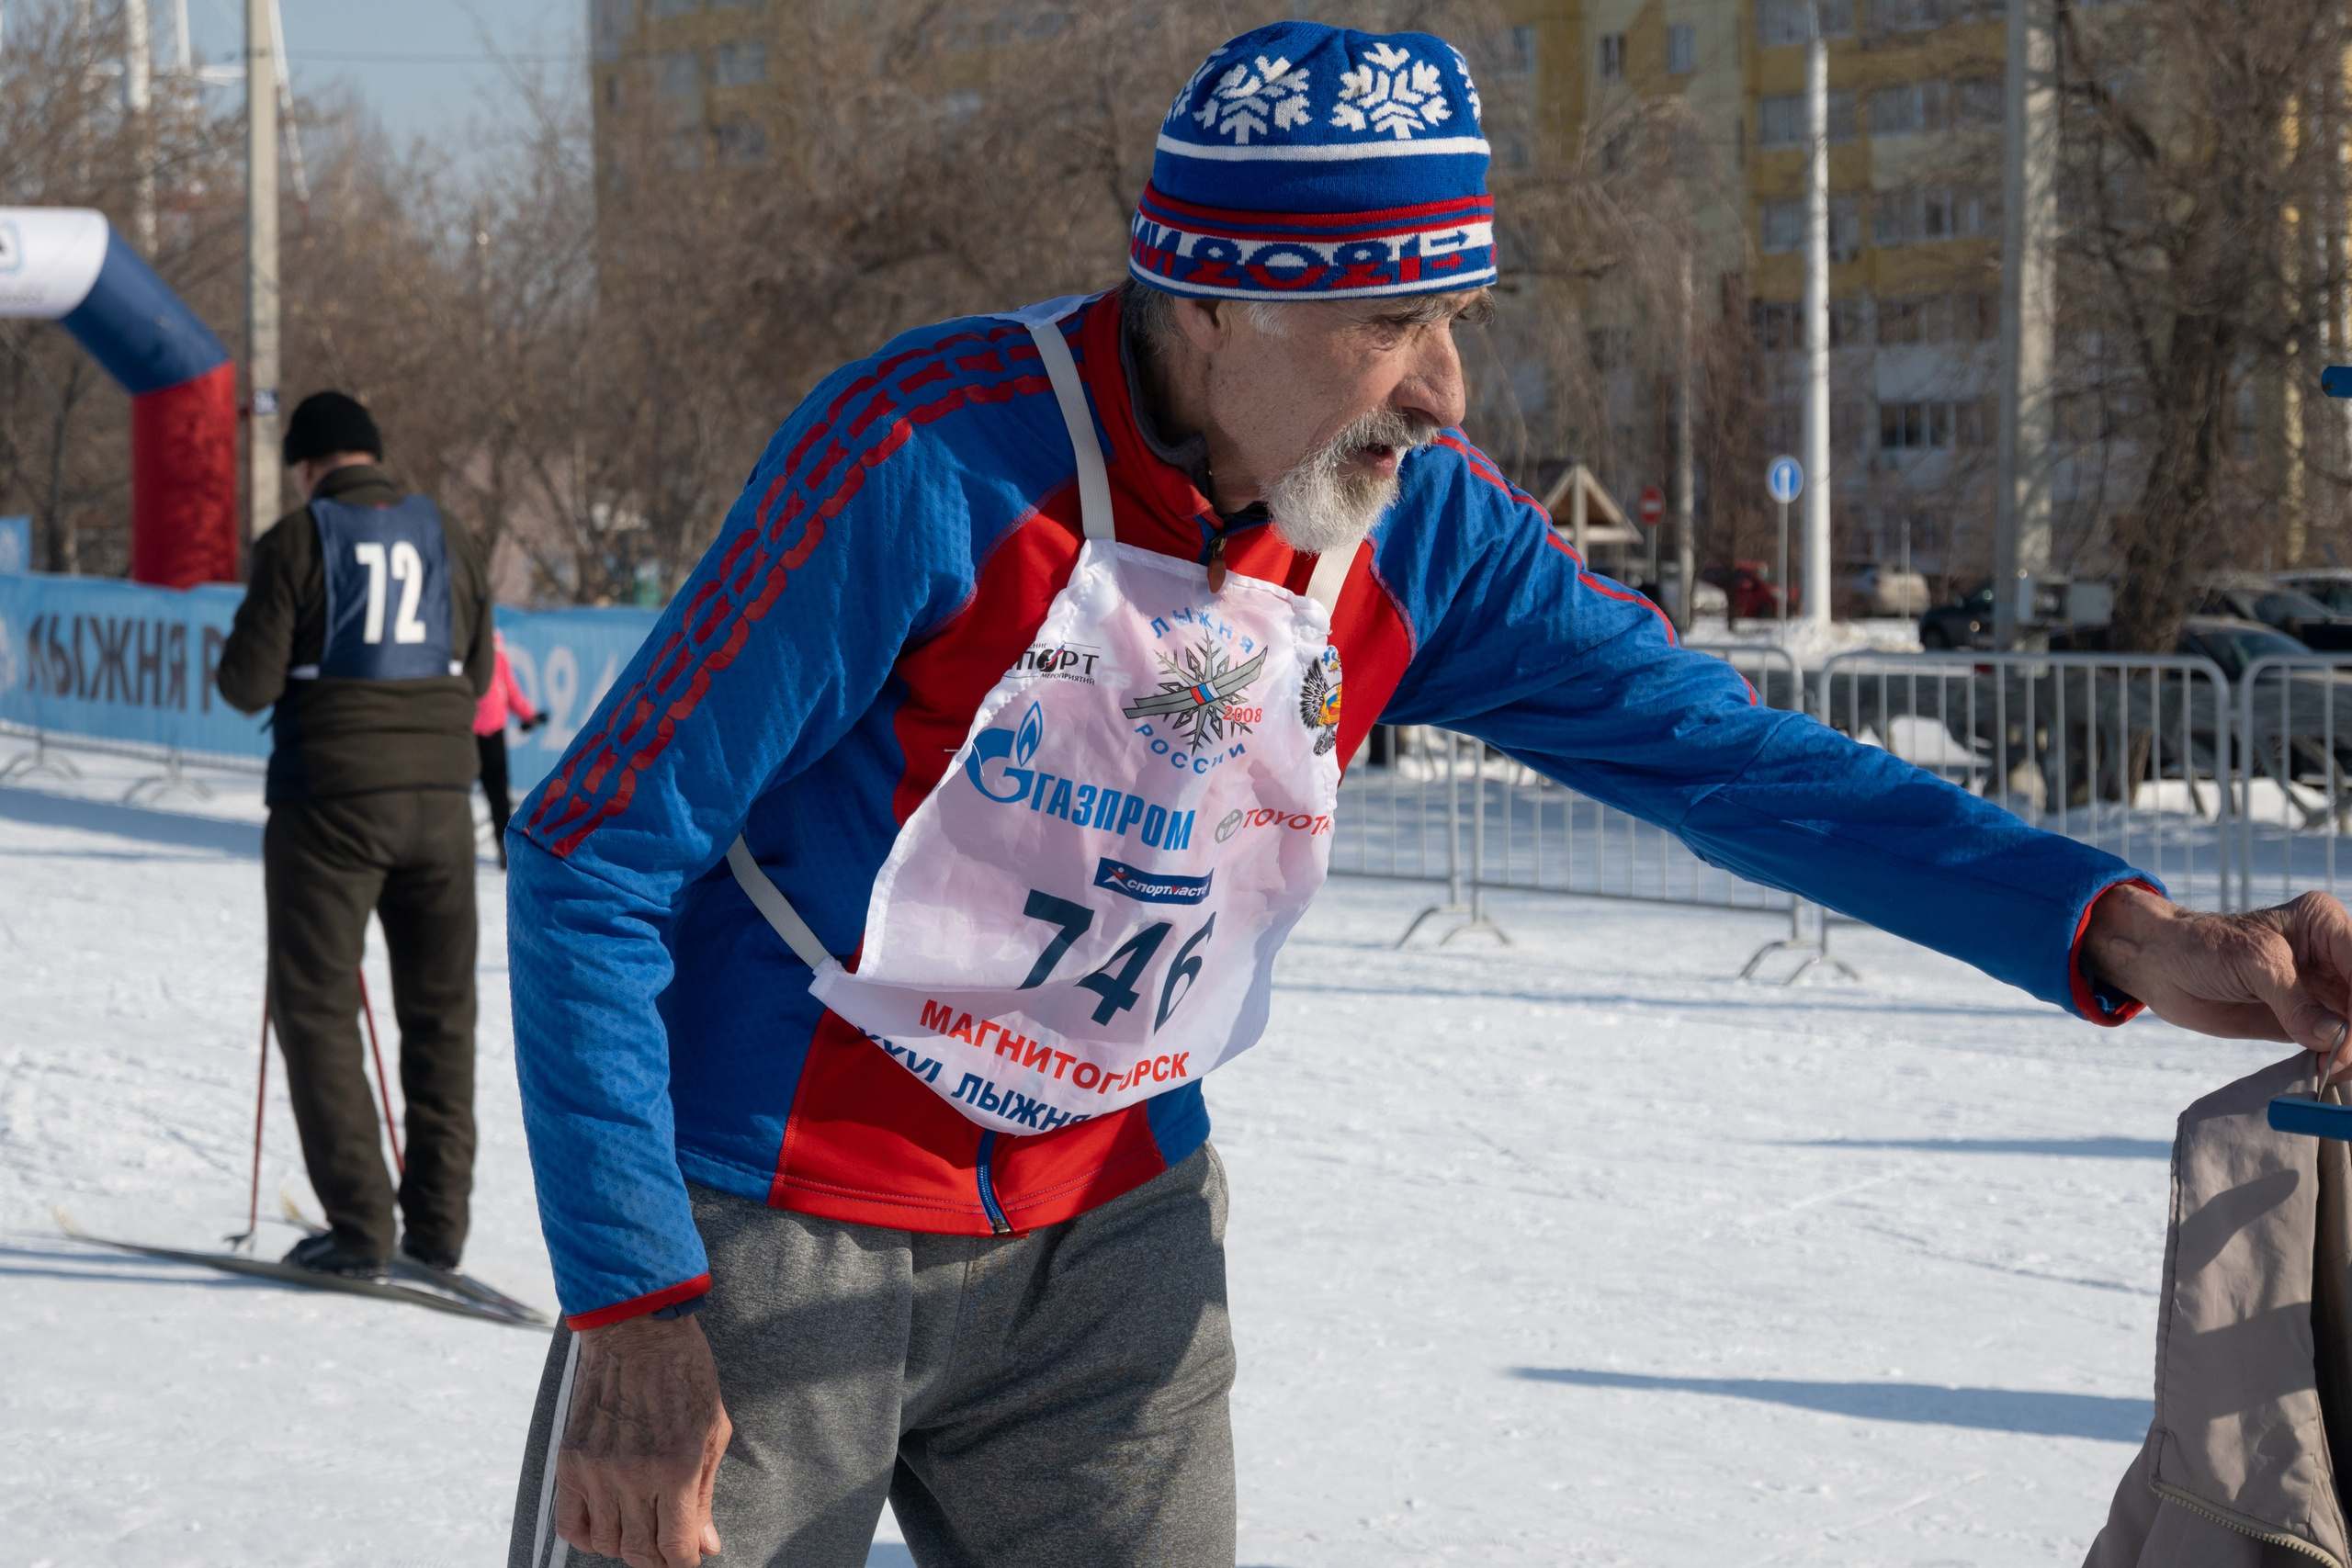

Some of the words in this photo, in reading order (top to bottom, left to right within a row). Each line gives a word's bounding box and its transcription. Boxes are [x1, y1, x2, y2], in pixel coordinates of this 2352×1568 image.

[1184, 233, 1421, 290] 2021
[356, 539, 426, 644] 72
[26, 614, 187, 713] ЛЫЖНЯ
[1150, 607, 1255, 655] ЛЫЖНЯ
[1040, 672, 1095, 686] МЕРОПРИЯТИЙ
[1135, 723, 1246, 774] РОССИИ
[1222, 705, 1263, 724] 2008
[1030, 772, 1196, 851] ГАЗПРОМ
[1014, 888, 1217, 1036] 746
[919, 998, 1190, 1095] МАГНИТОГОРСК
